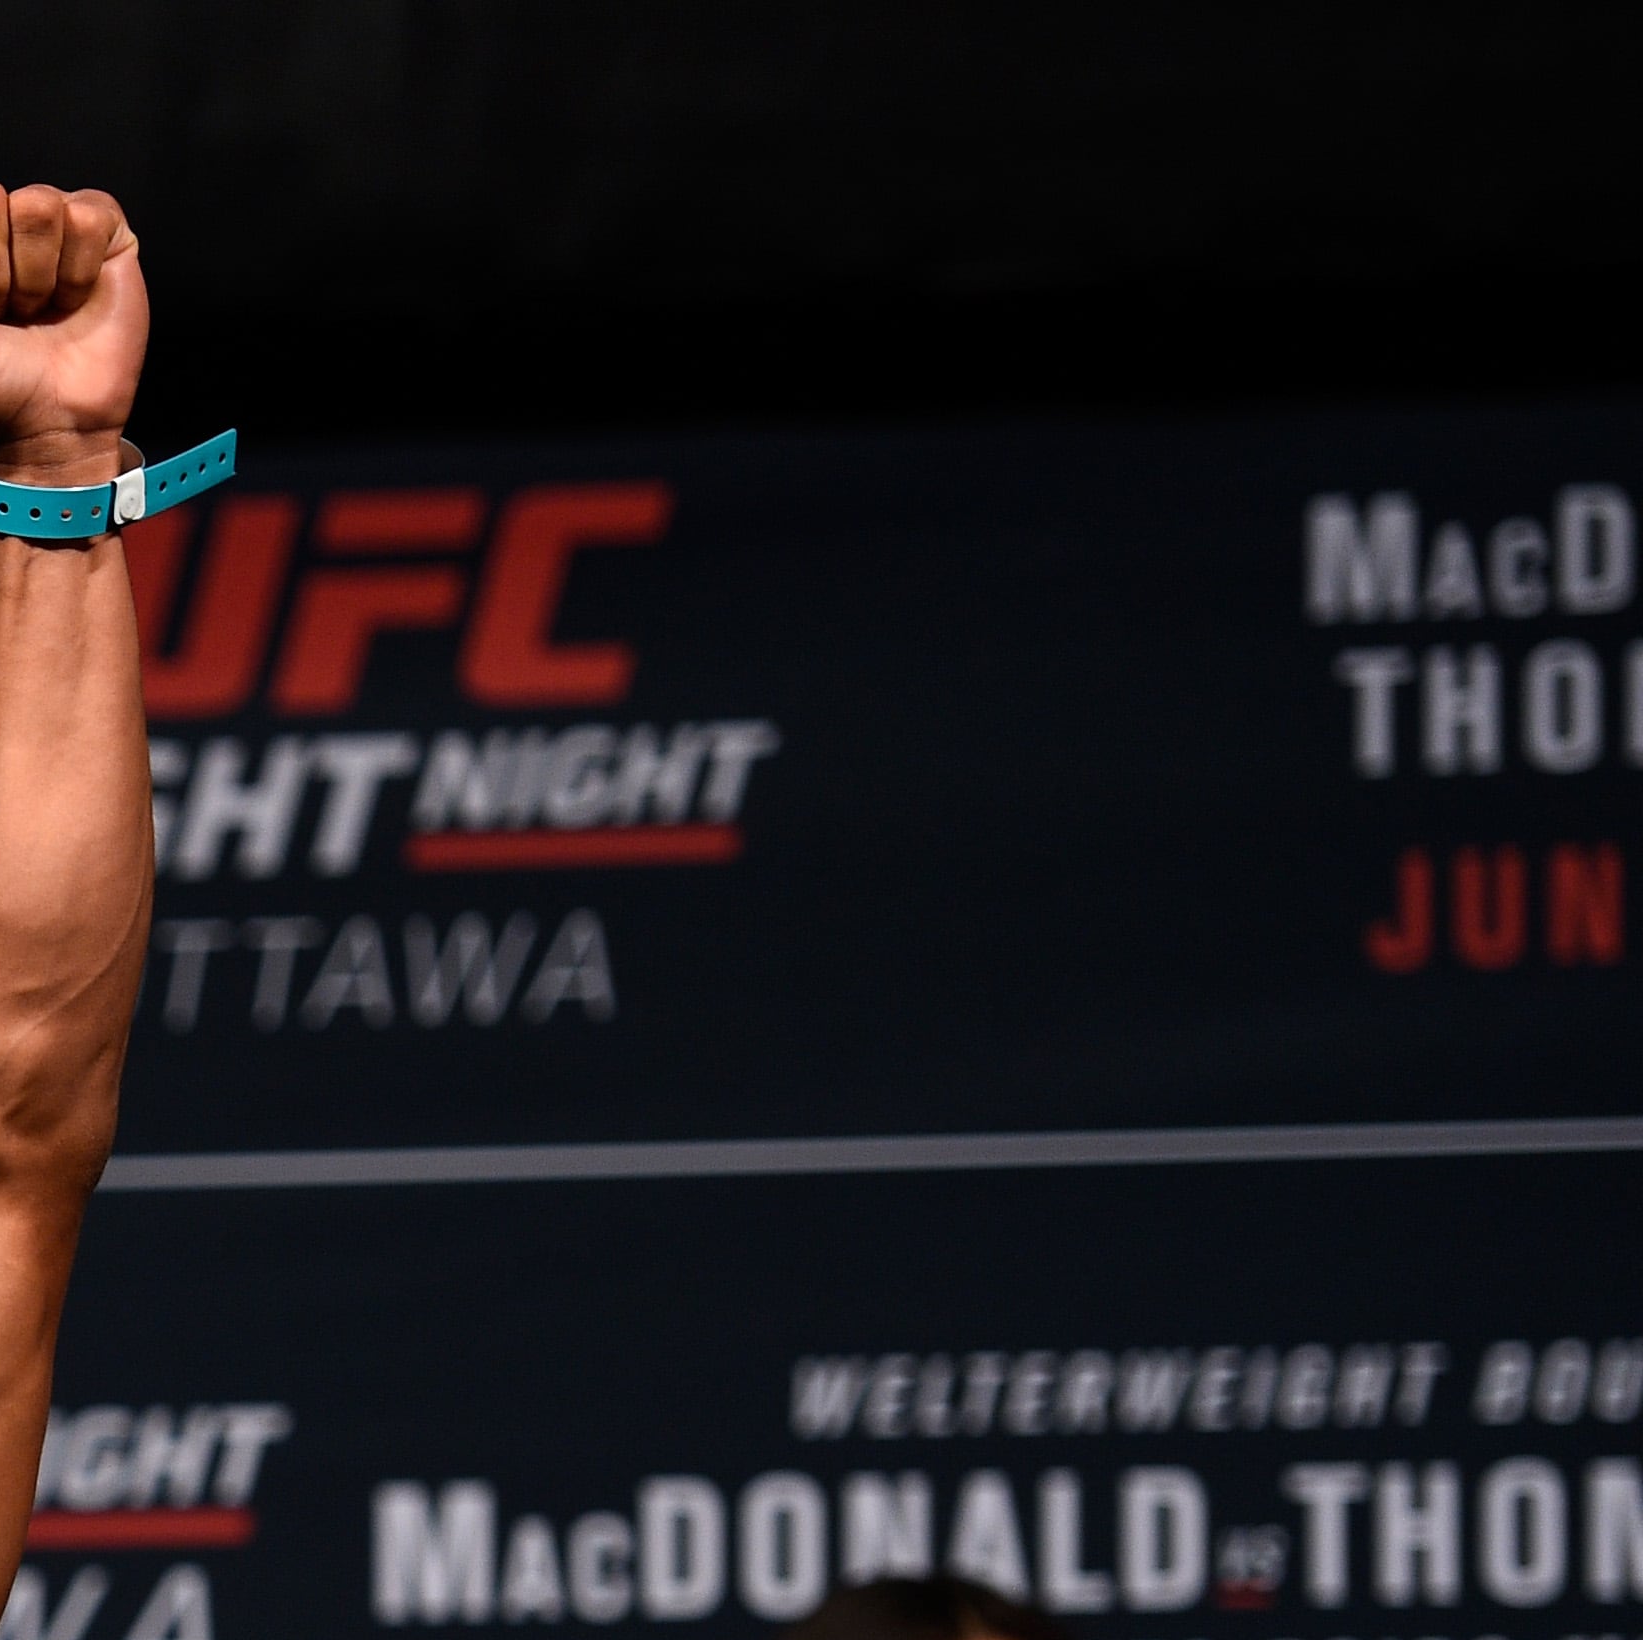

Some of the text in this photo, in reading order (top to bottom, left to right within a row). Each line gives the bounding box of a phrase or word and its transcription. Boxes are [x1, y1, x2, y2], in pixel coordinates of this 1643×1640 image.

[118, 480, 677, 718] UFC
[1337, 641, 1643, 776] THO
[412, 719, 779, 832] NIGHT
[1365, 845, 1624, 972] JUN
[789, 1341, 1445, 1438] WELTERWEIGHT
